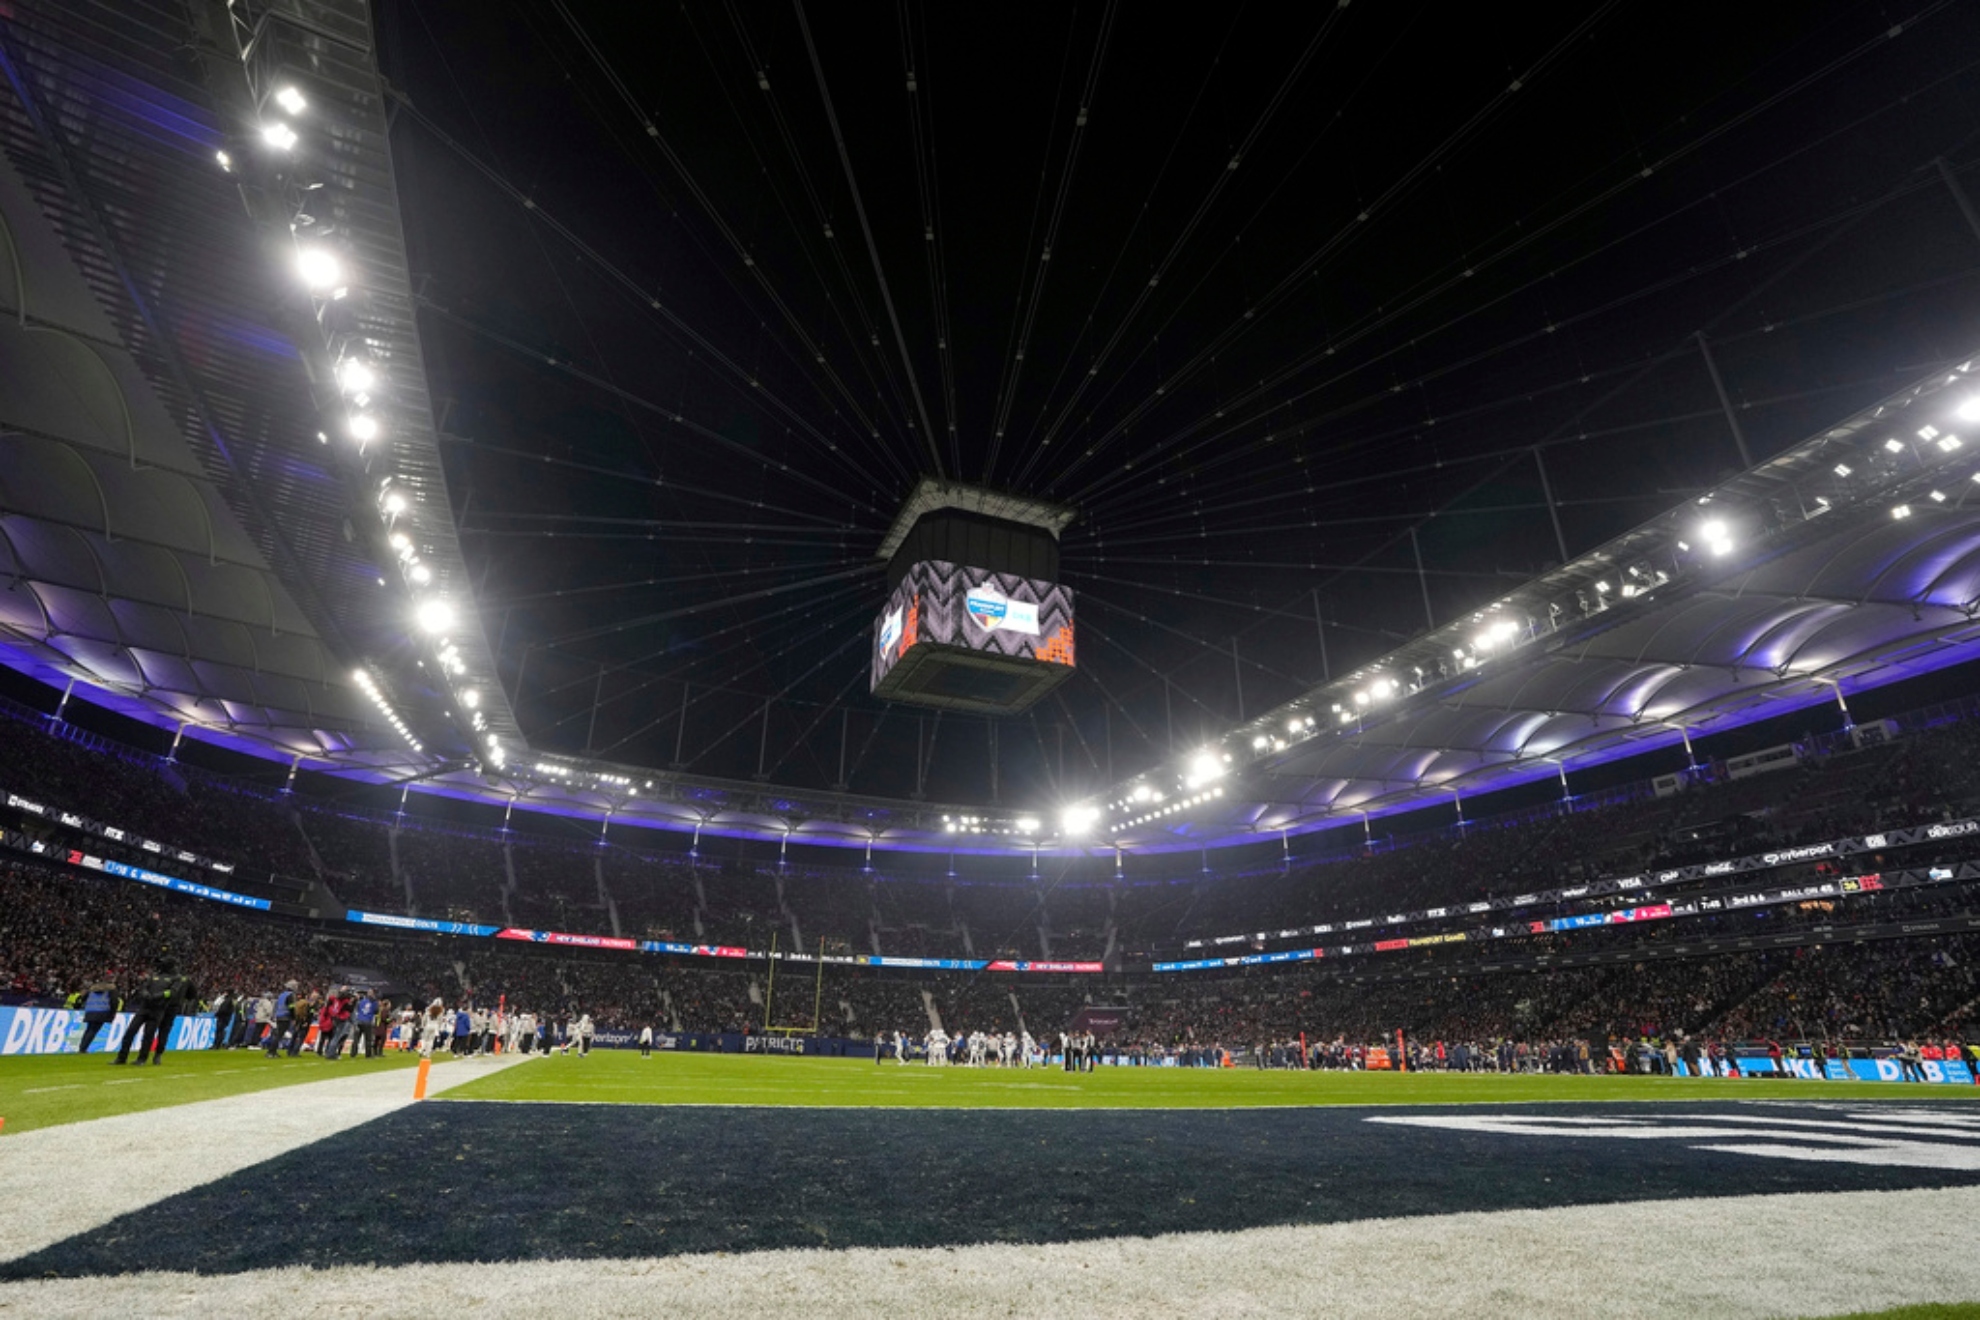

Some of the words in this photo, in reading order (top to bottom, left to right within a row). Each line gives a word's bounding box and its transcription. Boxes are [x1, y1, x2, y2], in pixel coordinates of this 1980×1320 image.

[1780, 844, 1833, 861] cyberport
[1617, 877, 1642, 888] VISA
[3, 1007, 70, 1054] DKB
[176, 1016, 212, 1050] DKB
